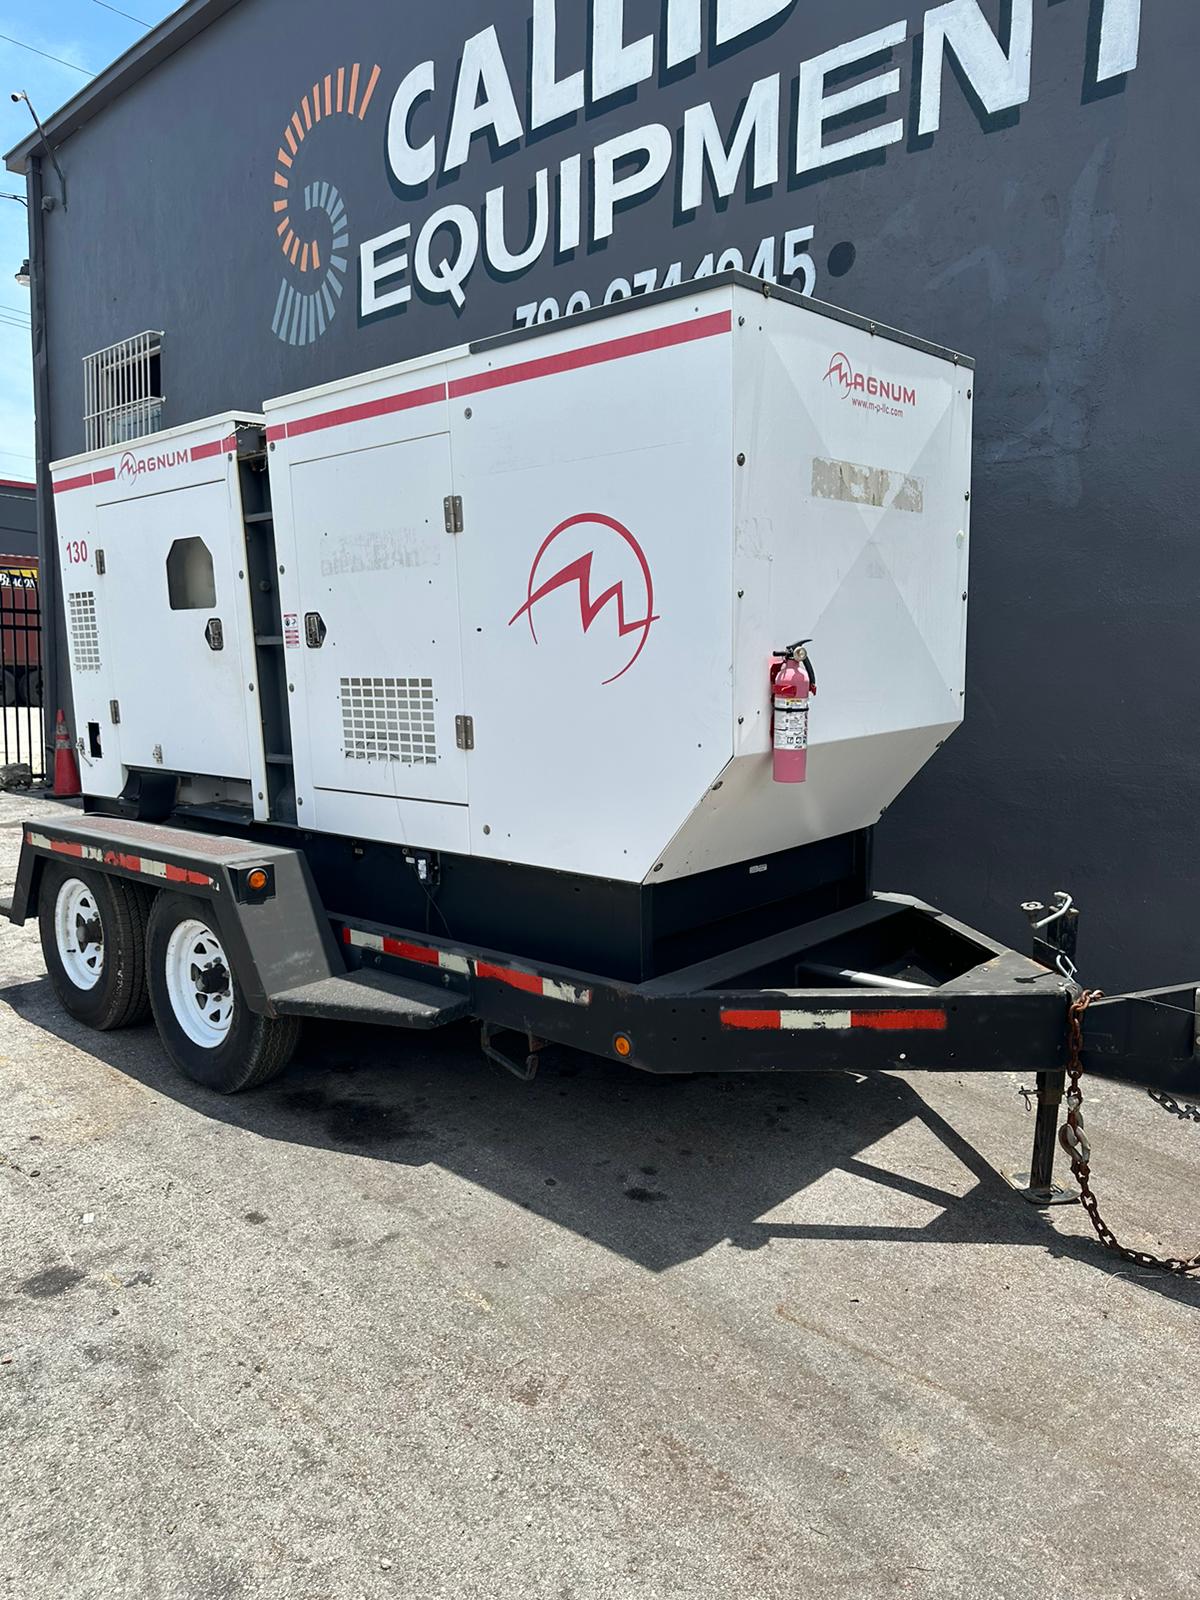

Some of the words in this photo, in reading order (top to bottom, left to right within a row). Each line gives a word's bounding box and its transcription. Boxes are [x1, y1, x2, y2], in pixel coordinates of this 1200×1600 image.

[388, 0, 793, 186] CALLI
[823, 352, 916, 406] MAGNUM
[117, 449, 189, 486] MAGNUM
[66, 540, 87, 563] 130
